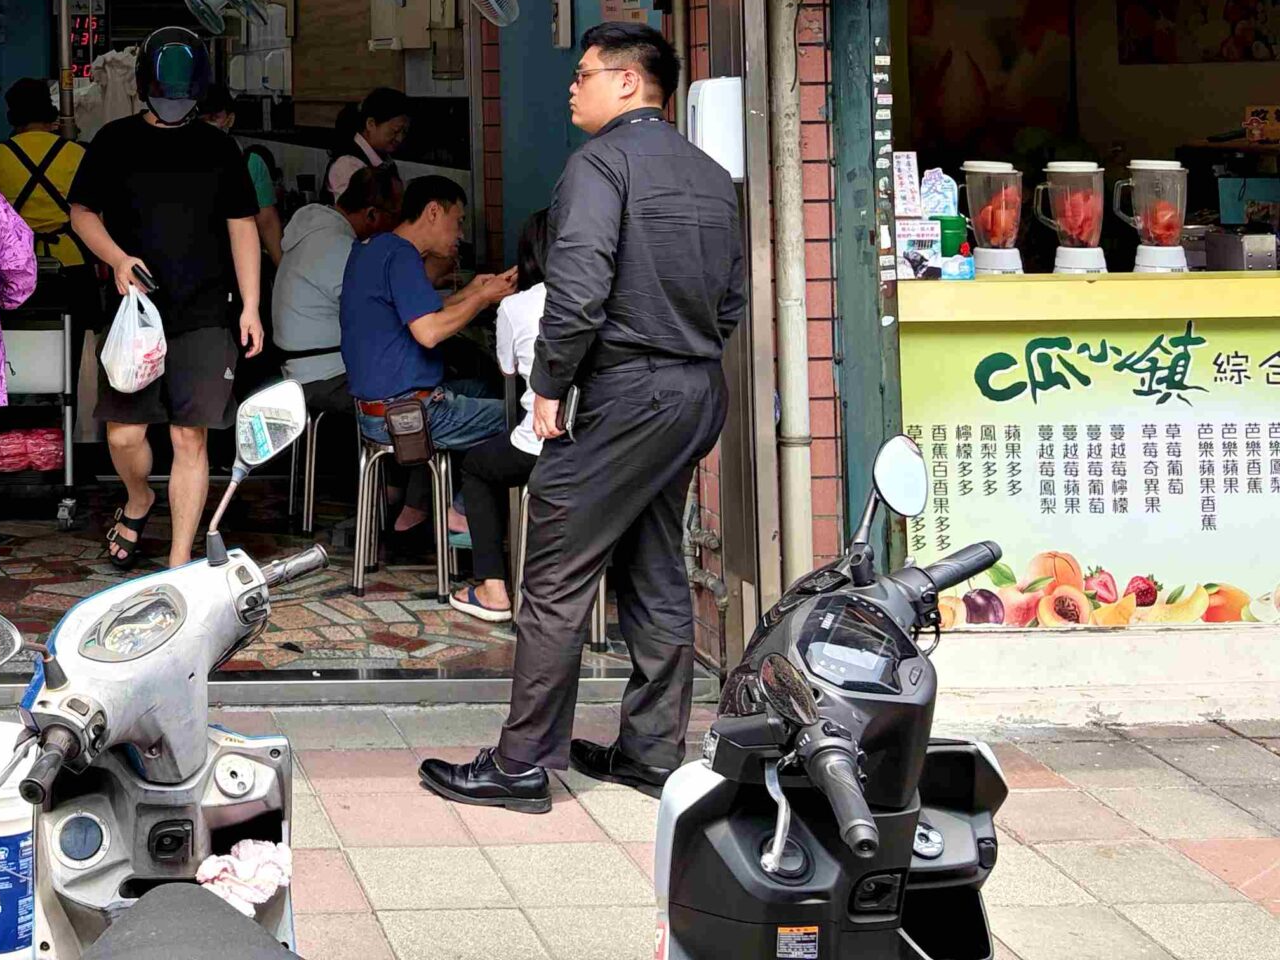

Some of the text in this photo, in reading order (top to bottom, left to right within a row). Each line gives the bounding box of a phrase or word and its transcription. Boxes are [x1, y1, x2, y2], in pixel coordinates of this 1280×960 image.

[932, 424, 951, 551] 香蕉百香果多多
[956, 424, 973, 496] 檸檬多多
[980, 424, 998, 496] 鳳梨多多
[1004, 424, 1022, 496] 蘋果多多
[1038, 424, 1056, 514] 蔓越莓鳳梨
[1062, 424, 1081, 514] 蔓越莓蘋果
[1086, 424, 1105, 514] 蔓越莓葡萄
[1109, 424, 1128, 514] 蔓越莓檸檬
[1141, 423, 1161, 513] 草莓奇異果
[1165, 423, 1184, 495] 草莓葡萄
[1197, 423, 1217, 531] 芭樂蘋果香蕉
[1221, 423, 1239, 494] 芭樂蘋果
[1245, 423, 1263, 494] 芭樂香蕉
